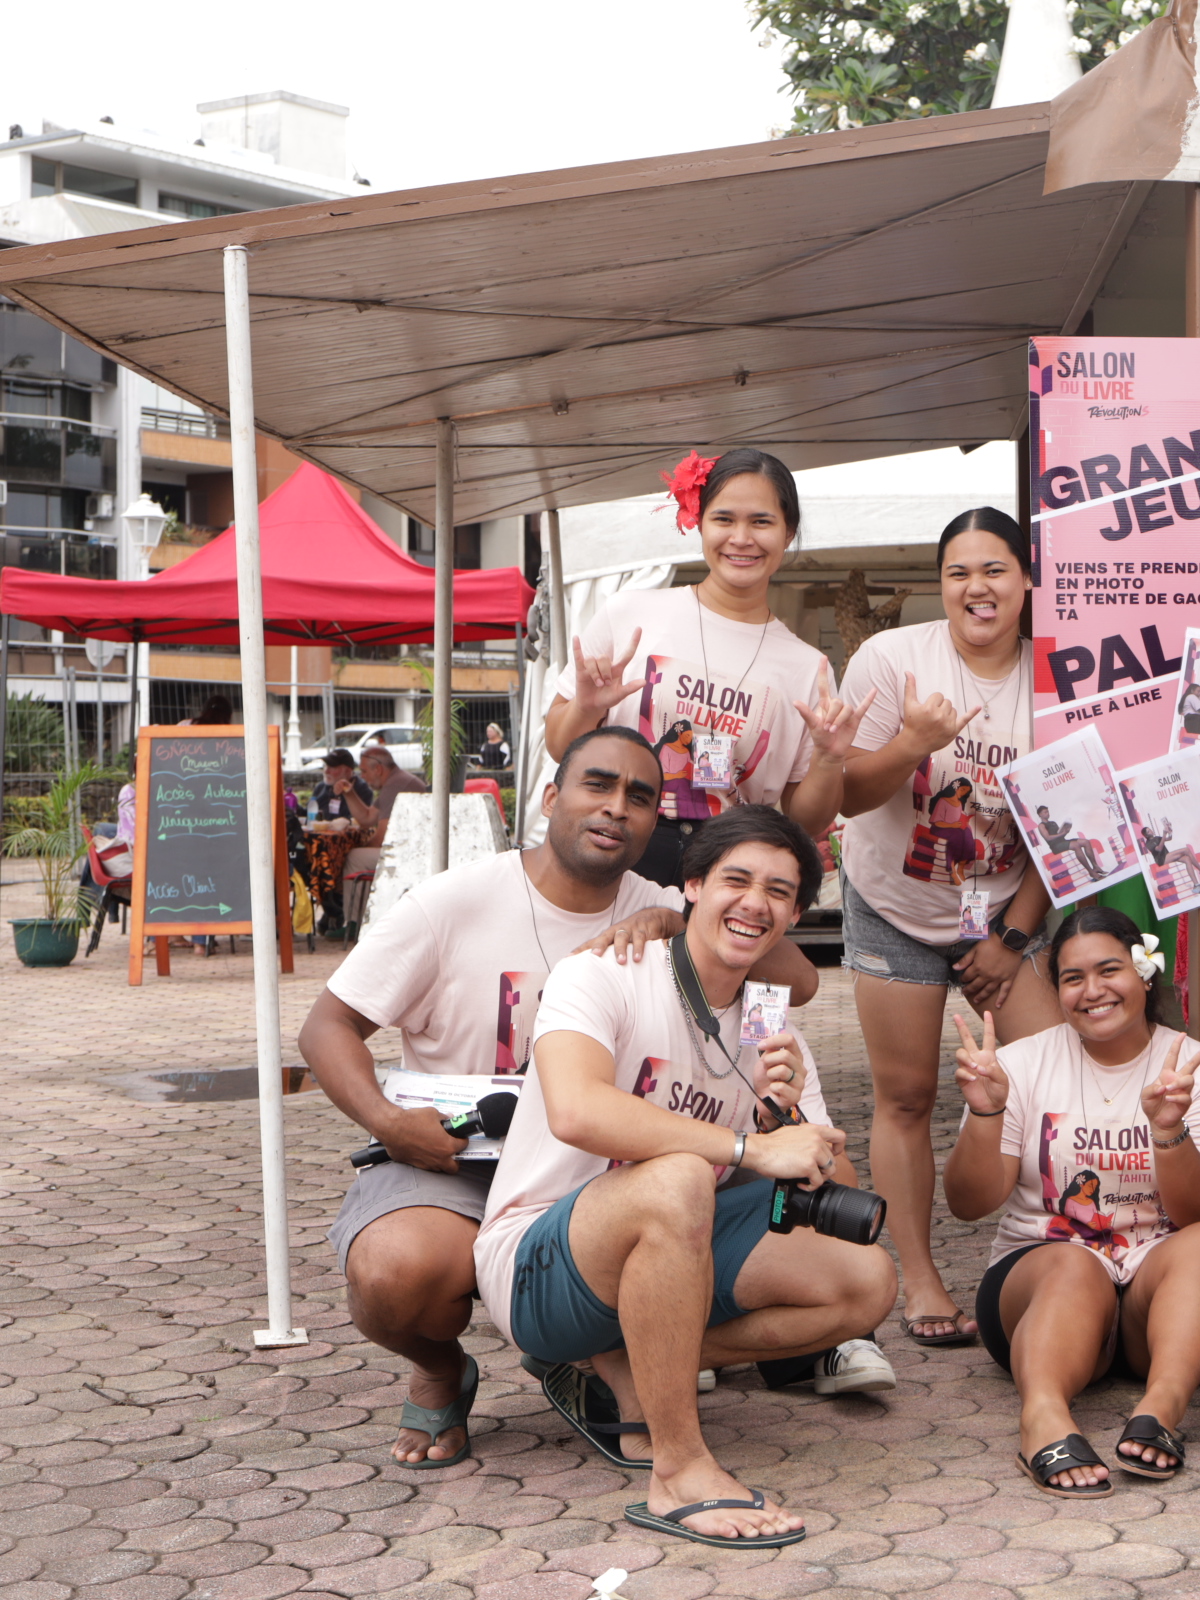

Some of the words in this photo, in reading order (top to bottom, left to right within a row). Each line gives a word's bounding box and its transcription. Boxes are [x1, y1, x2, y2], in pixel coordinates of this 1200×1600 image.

[1057, 352, 1136, 379] SALON
[1060, 381, 1080, 395] DU
[1083, 381, 1135, 400] LIVRE
[1056, 562, 1108, 574] VIENS
[1113, 562, 1135, 574] TE
[1055, 578, 1081, 590] EN
[1085, 578, 1144, 590] PHOTO
[1056, 593, 1077, 605] ET
[1085, 593, 1140, 605] TENTE
[1145, 593, 1168, 605] DE
[1056, 608, 1079, 620] TA
[1047, 624, 1182, 703] PAL
[676, 674, 753, 718] SALON
[1065, 703, 1103, 723] PILE
[1108, 696, 1120, 712] À
[1125, 688, 1162, 708] LIRE
[676, 701, 694, 716] DU
[694, 706, 746, 738] LIVRE
[953, 735, 1018, 768] SALON
[955, 760, 970, 775] DU
[1042, 761, 1066, 778] SALON
[1042, 780, 1054, 791] DU
[1055, 769, 1076, 788] LIVRE
[1158, 772, 1182, 787] SALON
[1157, 789, 1168, 800] DU
[1169, 781, 1190, 797] LIVRE
[668, 1081, 724, 1124] SAON
[1073, 1125, 1149, 1151] SALON
[1075, 1152, 1094, 1166] DU
[1098, 1151, 1151, 1170] LIVRE
[1118, 1173, 1151, 1183] TAHITI
[774, 1199, 782, 1221] PHOTO
